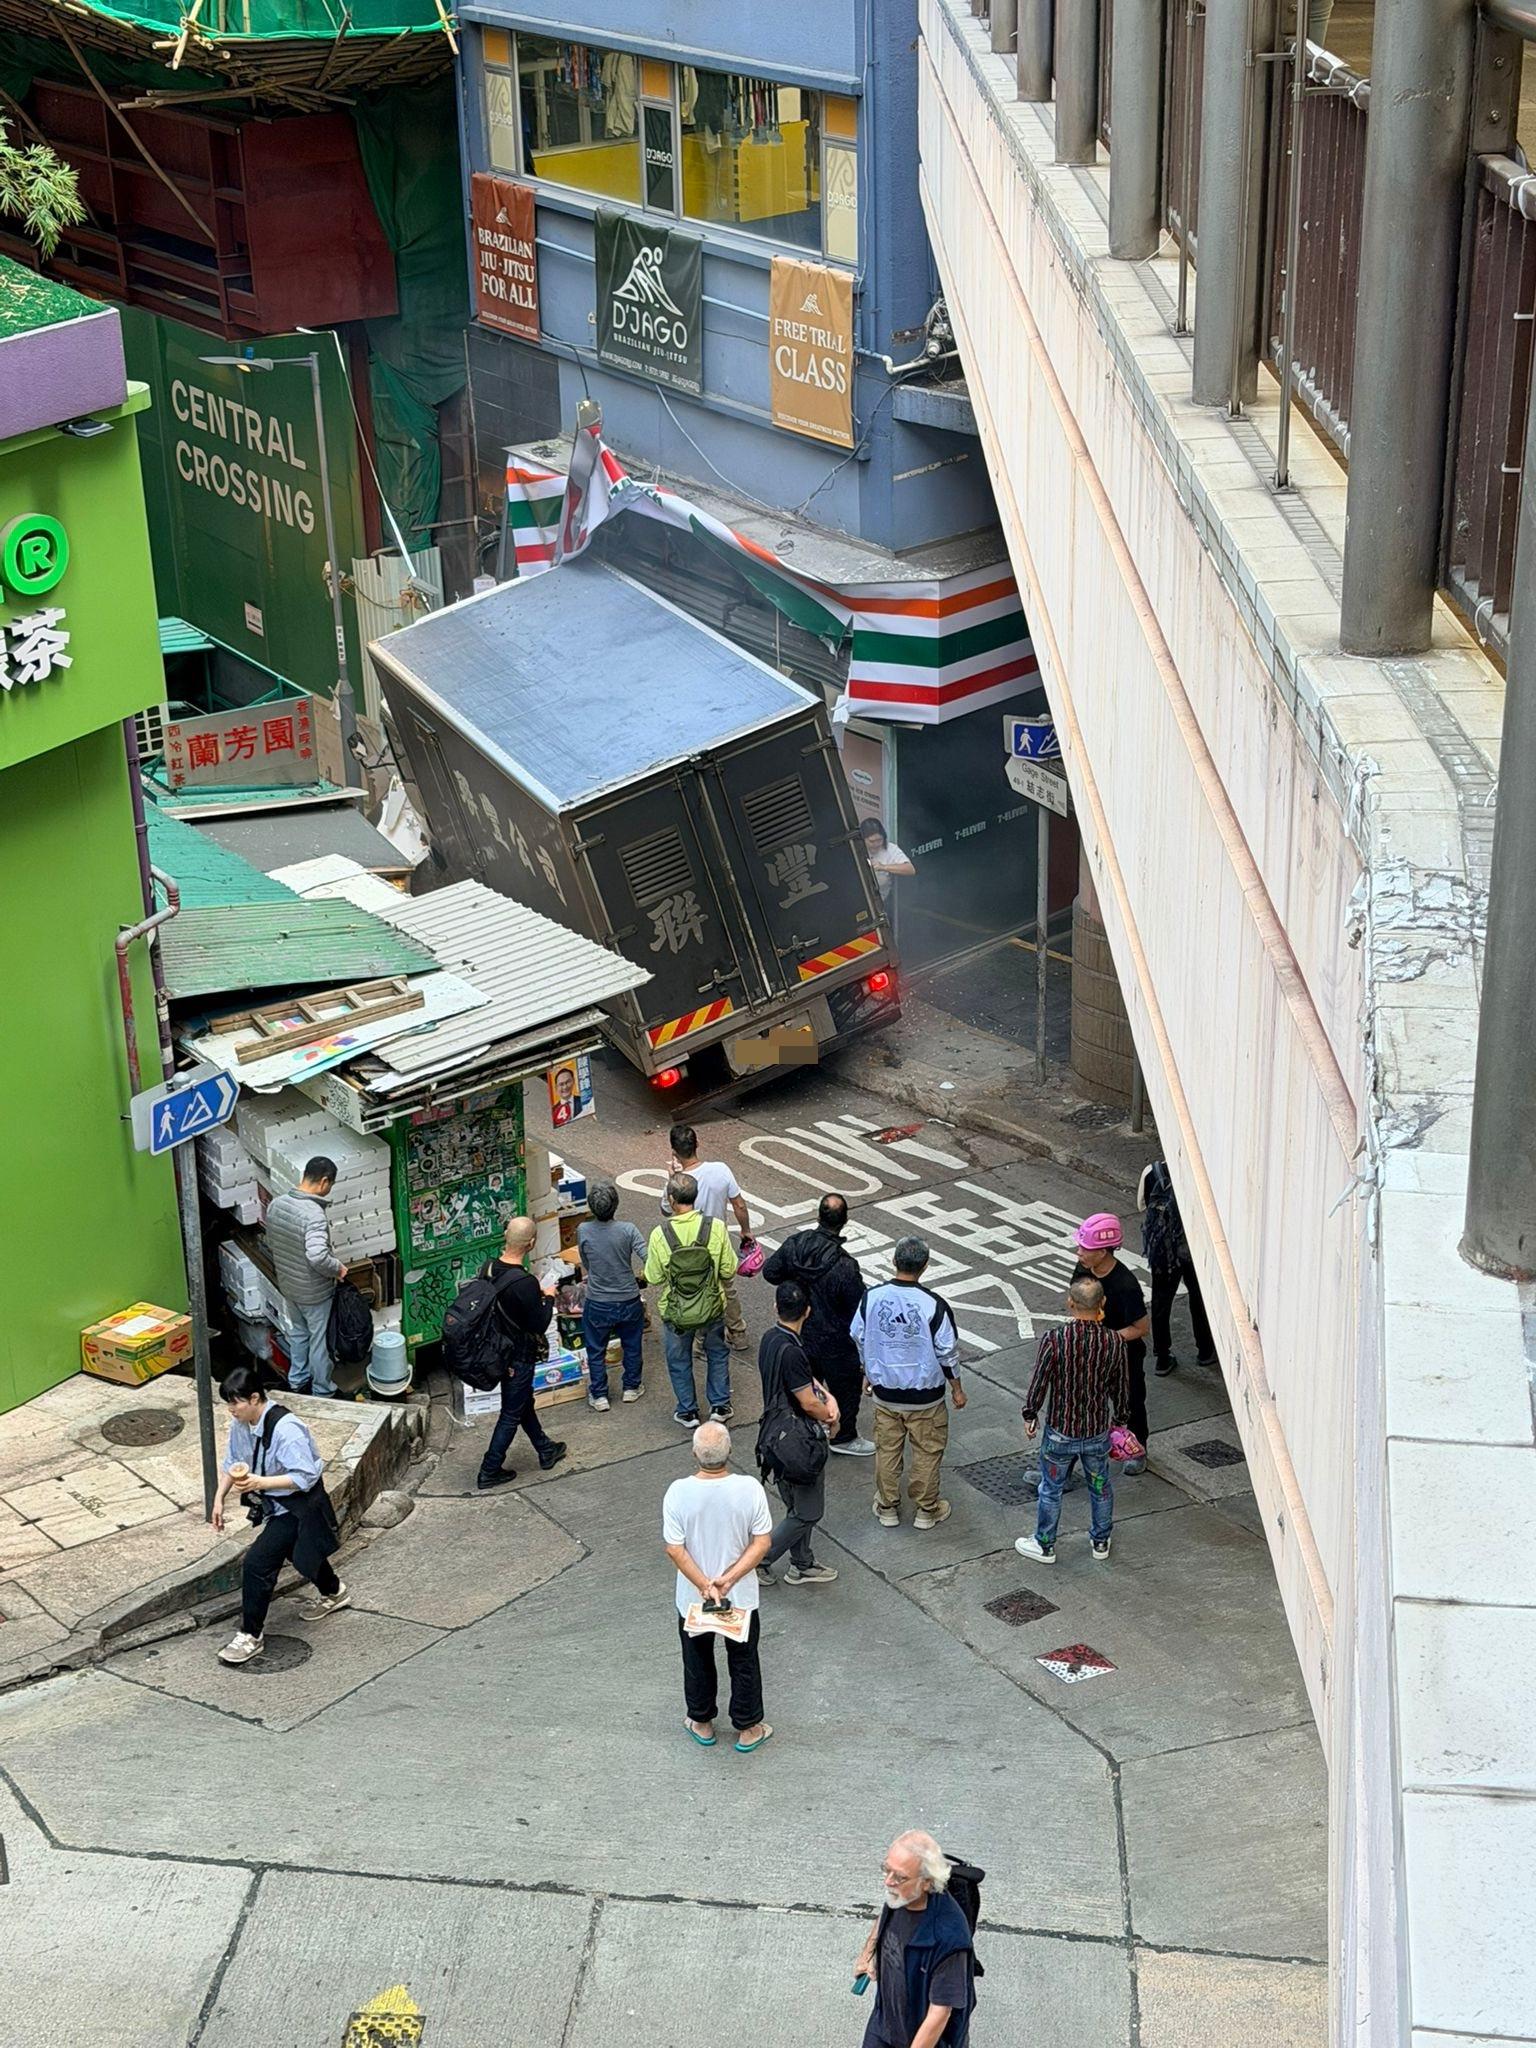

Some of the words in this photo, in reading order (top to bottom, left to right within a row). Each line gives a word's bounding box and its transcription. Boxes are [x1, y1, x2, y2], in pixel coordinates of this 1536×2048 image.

[478, 227, 533, 259] BRAZILIAN
[481, 272, 508, 301] FOR
[509, 282, 537, 310] ALL
[612, 300, 688, 349] D'JAGO
[613, 332, 651, 353] BRAZILIAN
[774, 318, 808, 343] FREE
[809, 326, 847, 354] TRIAL
[775, 345, 847, 395] CLASS
[171, 379, 307, 470] CENTRAL
[175, 439, 315, 534] CROSSING
[186, 715, 295, 771] 蘭芳園
[1021, 763, 1039, 779] Gage
[557, 1105, 567, 1120] 4
[616, 1114, 969, 1233] SLOW
